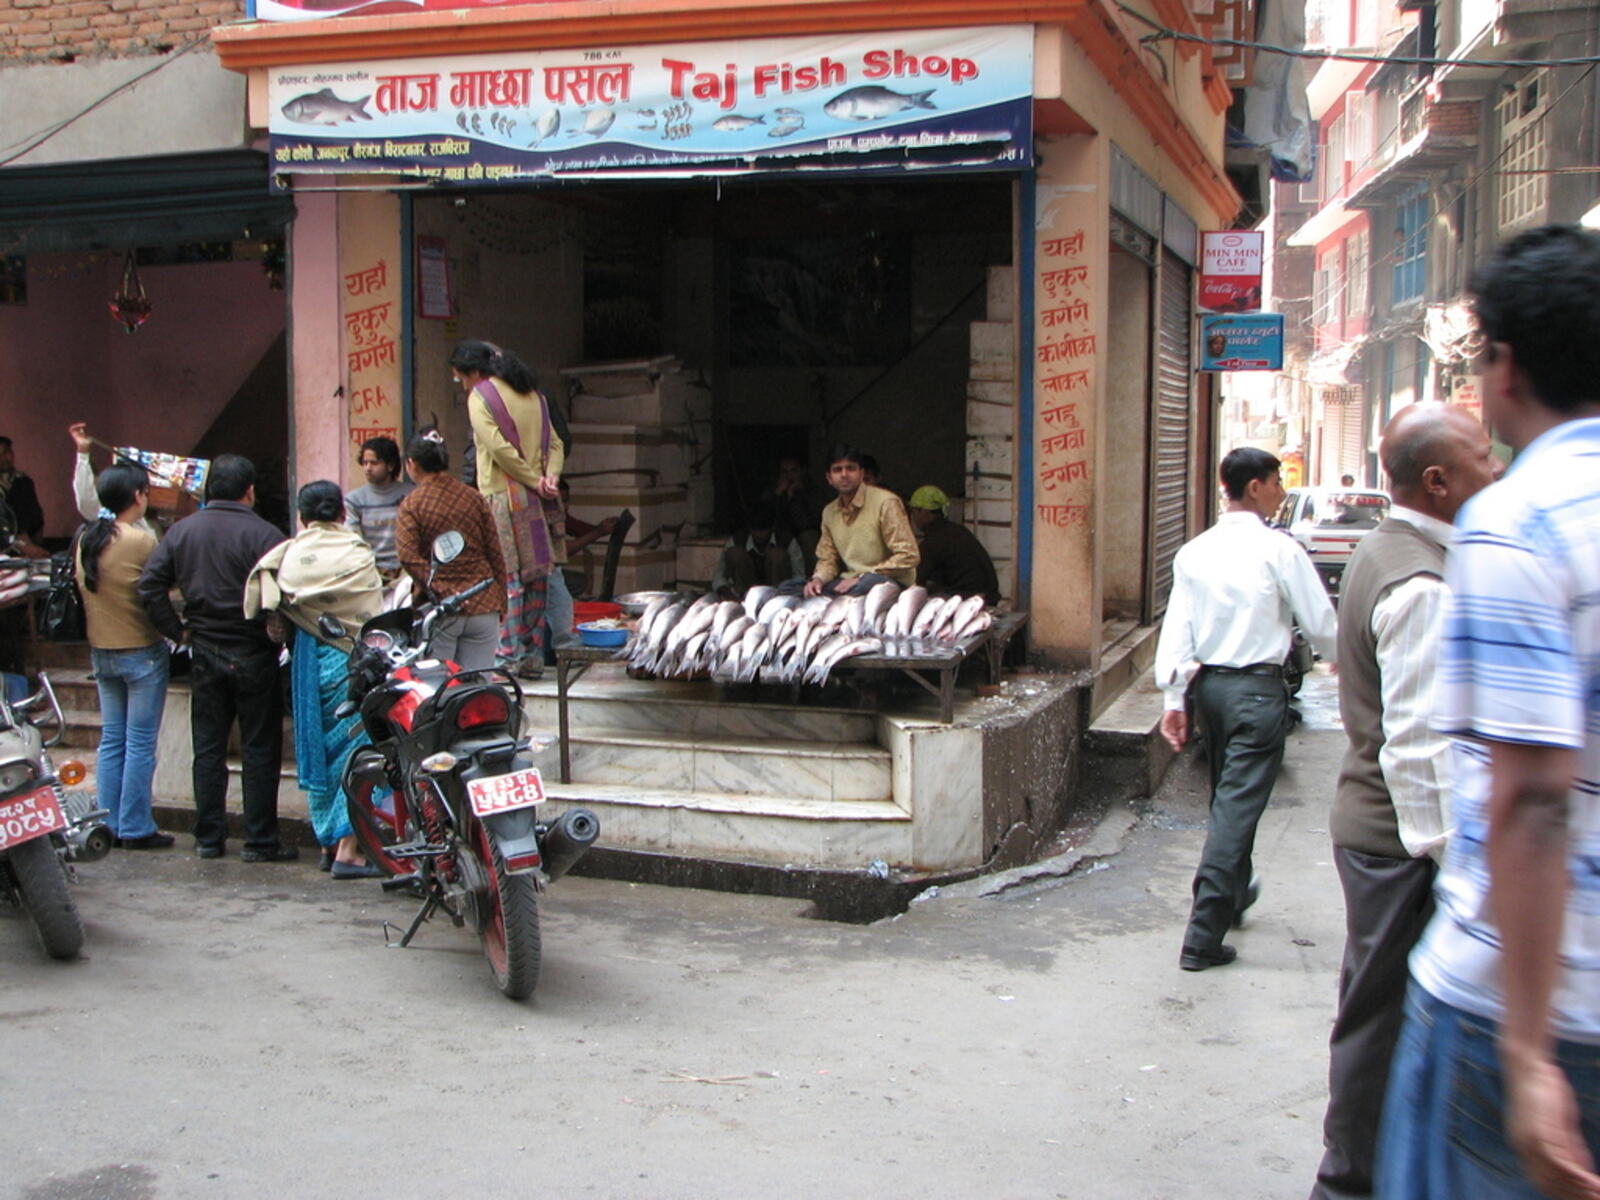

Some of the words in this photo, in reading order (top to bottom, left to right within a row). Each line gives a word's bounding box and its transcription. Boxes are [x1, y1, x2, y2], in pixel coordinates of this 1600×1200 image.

[375, 74, 441, 114] ताज
[450, 67, 533, 111] माछा
[543, 63, 633, 106] पसल
[661, 57, 738, 110] Taj
[754, 56, 847, 97] Fish
[862, 49, 979, 84] Shop
[1206, 249, 1230, 257] MIN
[1234, 249, 1259, 257] MIN
[1216, 258, 1248, 267] CAFE
